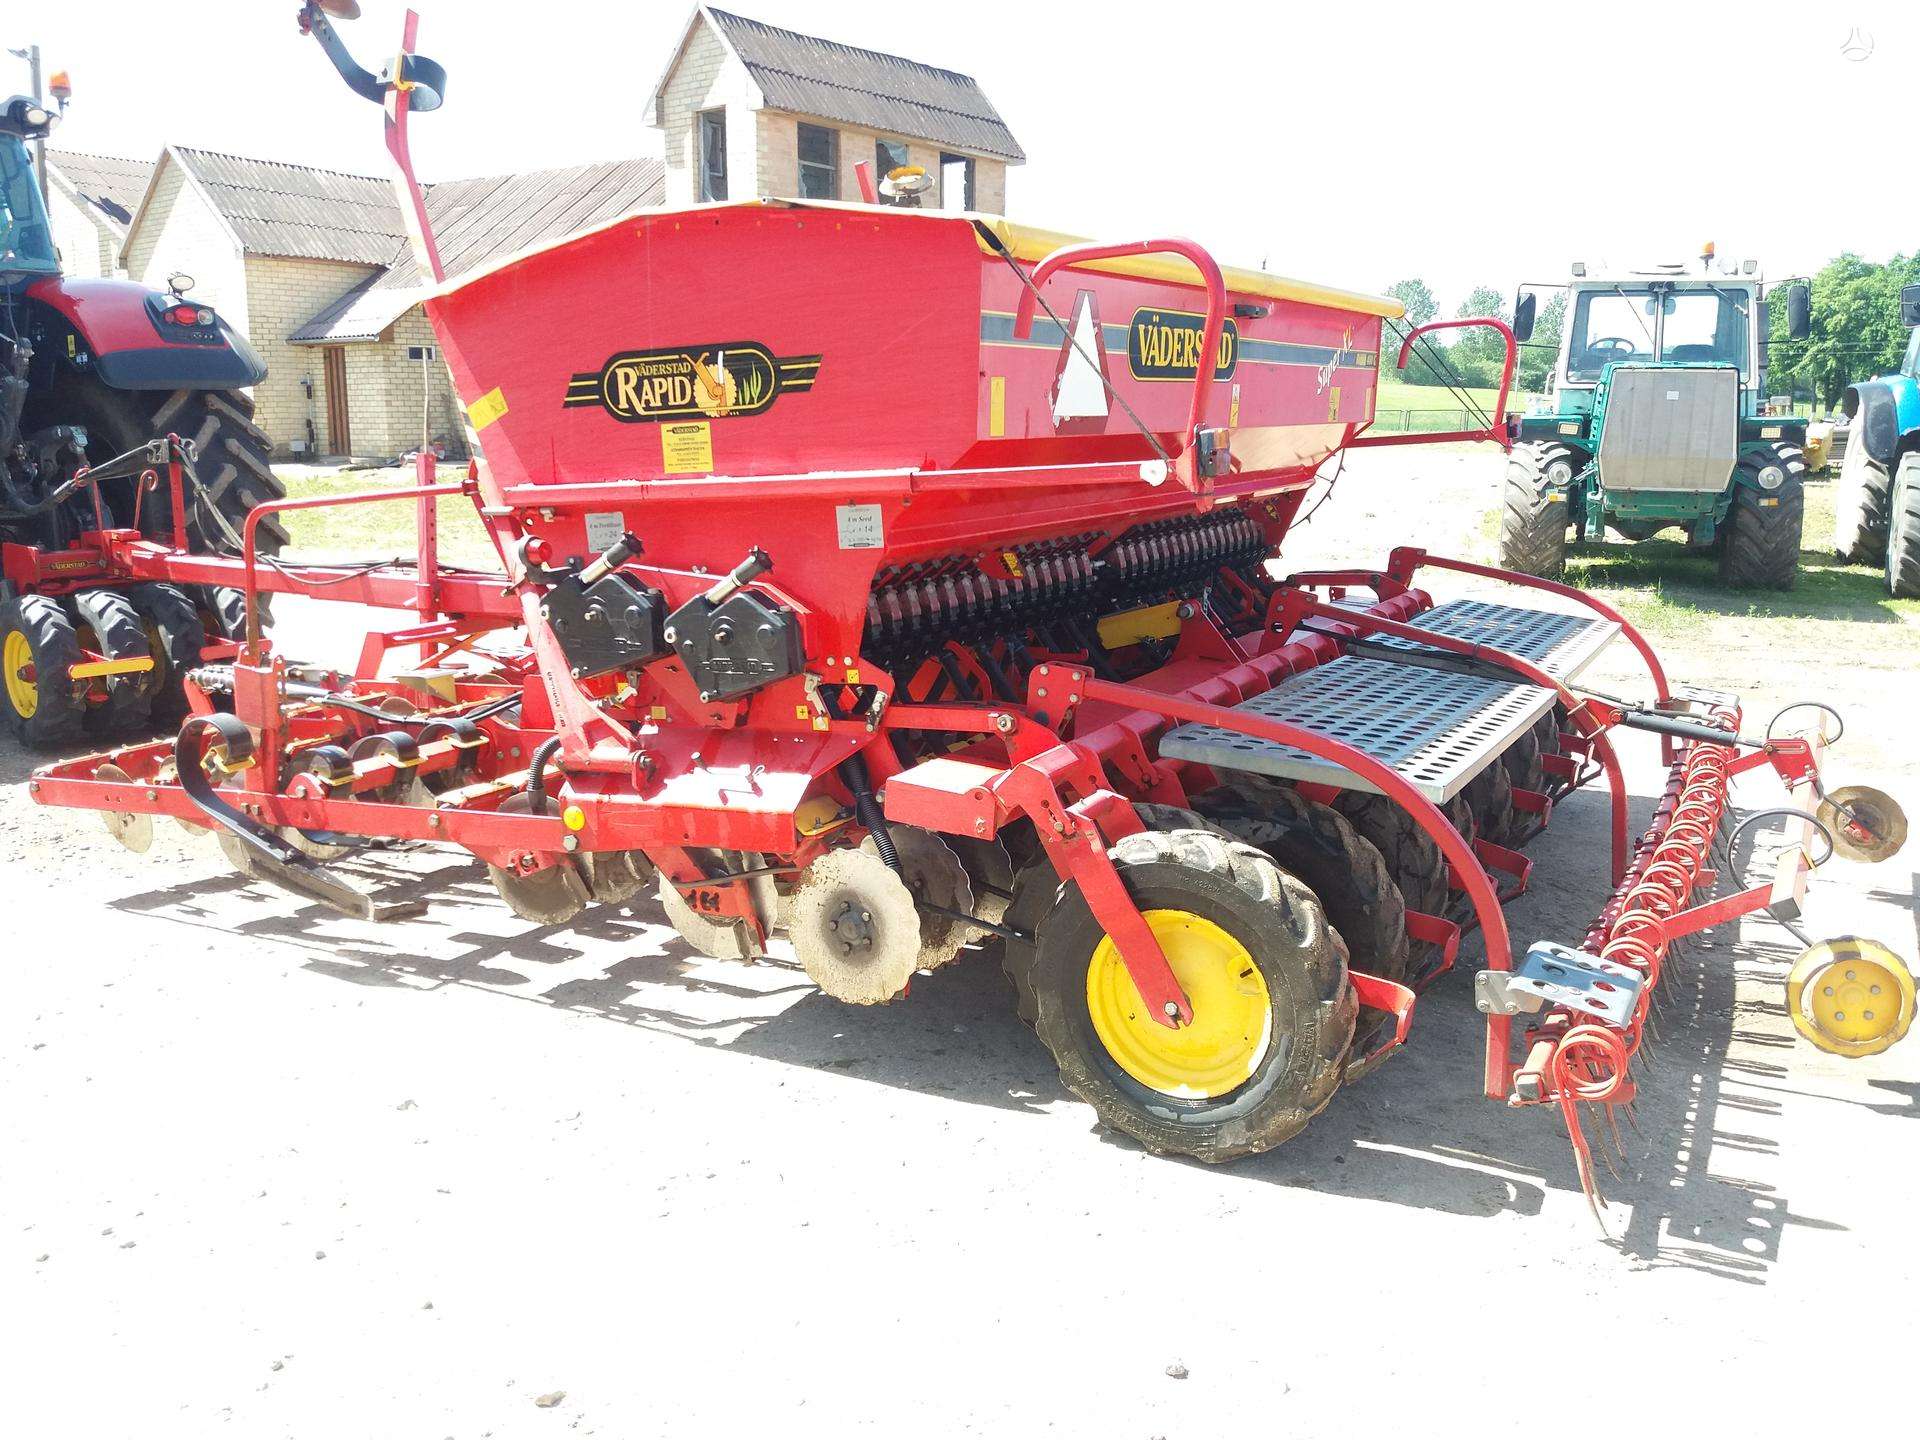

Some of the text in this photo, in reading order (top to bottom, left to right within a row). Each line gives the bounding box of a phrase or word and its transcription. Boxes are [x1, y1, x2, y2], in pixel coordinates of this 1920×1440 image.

[1137, 314, 1233, 369] VÄDERSD
[615, 367, 693, 414] RAPID
[635, 361, 692, 377] VÄDERSTAD
